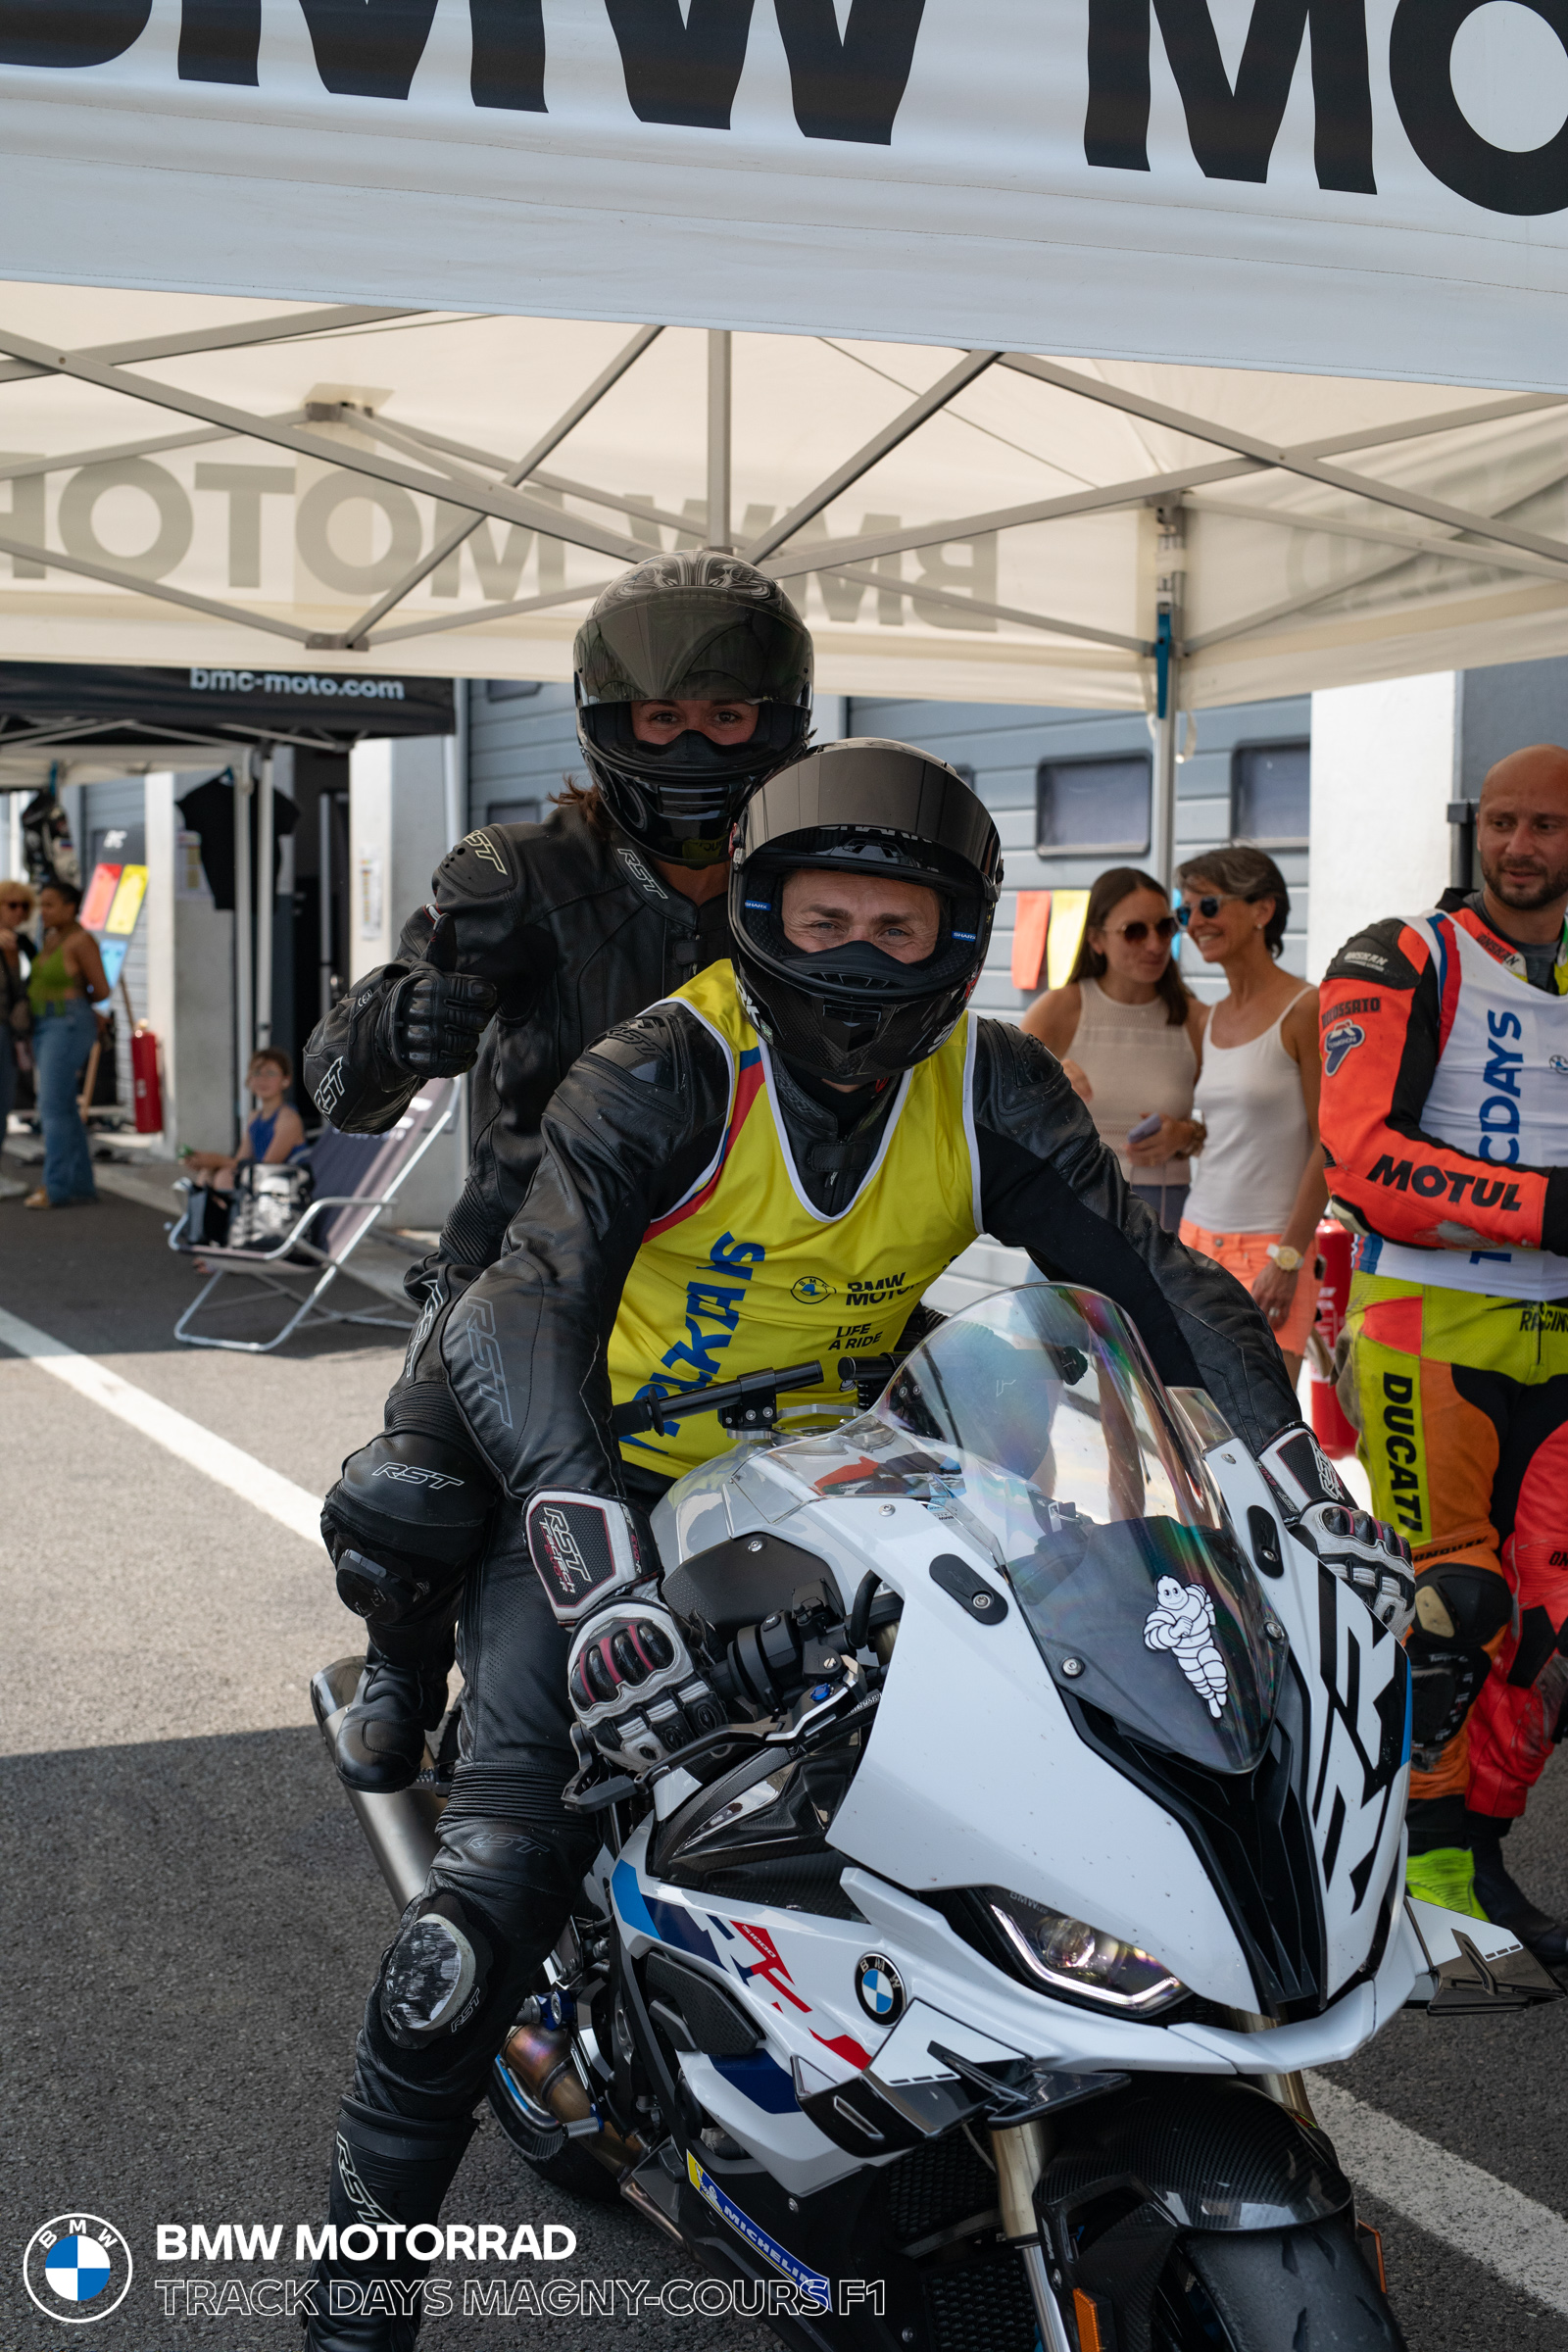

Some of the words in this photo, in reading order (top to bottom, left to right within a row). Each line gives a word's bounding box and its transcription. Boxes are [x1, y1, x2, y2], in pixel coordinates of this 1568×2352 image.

[0, 0, 927, 146] MW
[189, 667, 406, 700] bmc-moto.com
[460, 829, 509, 875] ST
[616, 848, 668, 900] RST
[1322, 997, 1382, 1029] OSSATO
[1366, 1153, 1523, 1211] MOTUL
[848, 1272, 906, 1293] BMW
[827, 1340, 841, 1350] A
[845, 1331, 883, 1349] RIDE
[836, 1323, 872, 1339] LIFE
[466, 1296, 514, 1429] RST
[371, 1451, 466, 1490] RST
[1383, 1372, 1423, 1533] DUCATI
[544, 1507, 592, 1583] RST
[462, 1833, 551, 1855] RST
[742, 1924, 777, 1959] S1000
[859, 1957, 902, 1989] BMW
[450, 1987, 480, 2033] RST
[723, 2205, 814, 2288] MICHELIN
